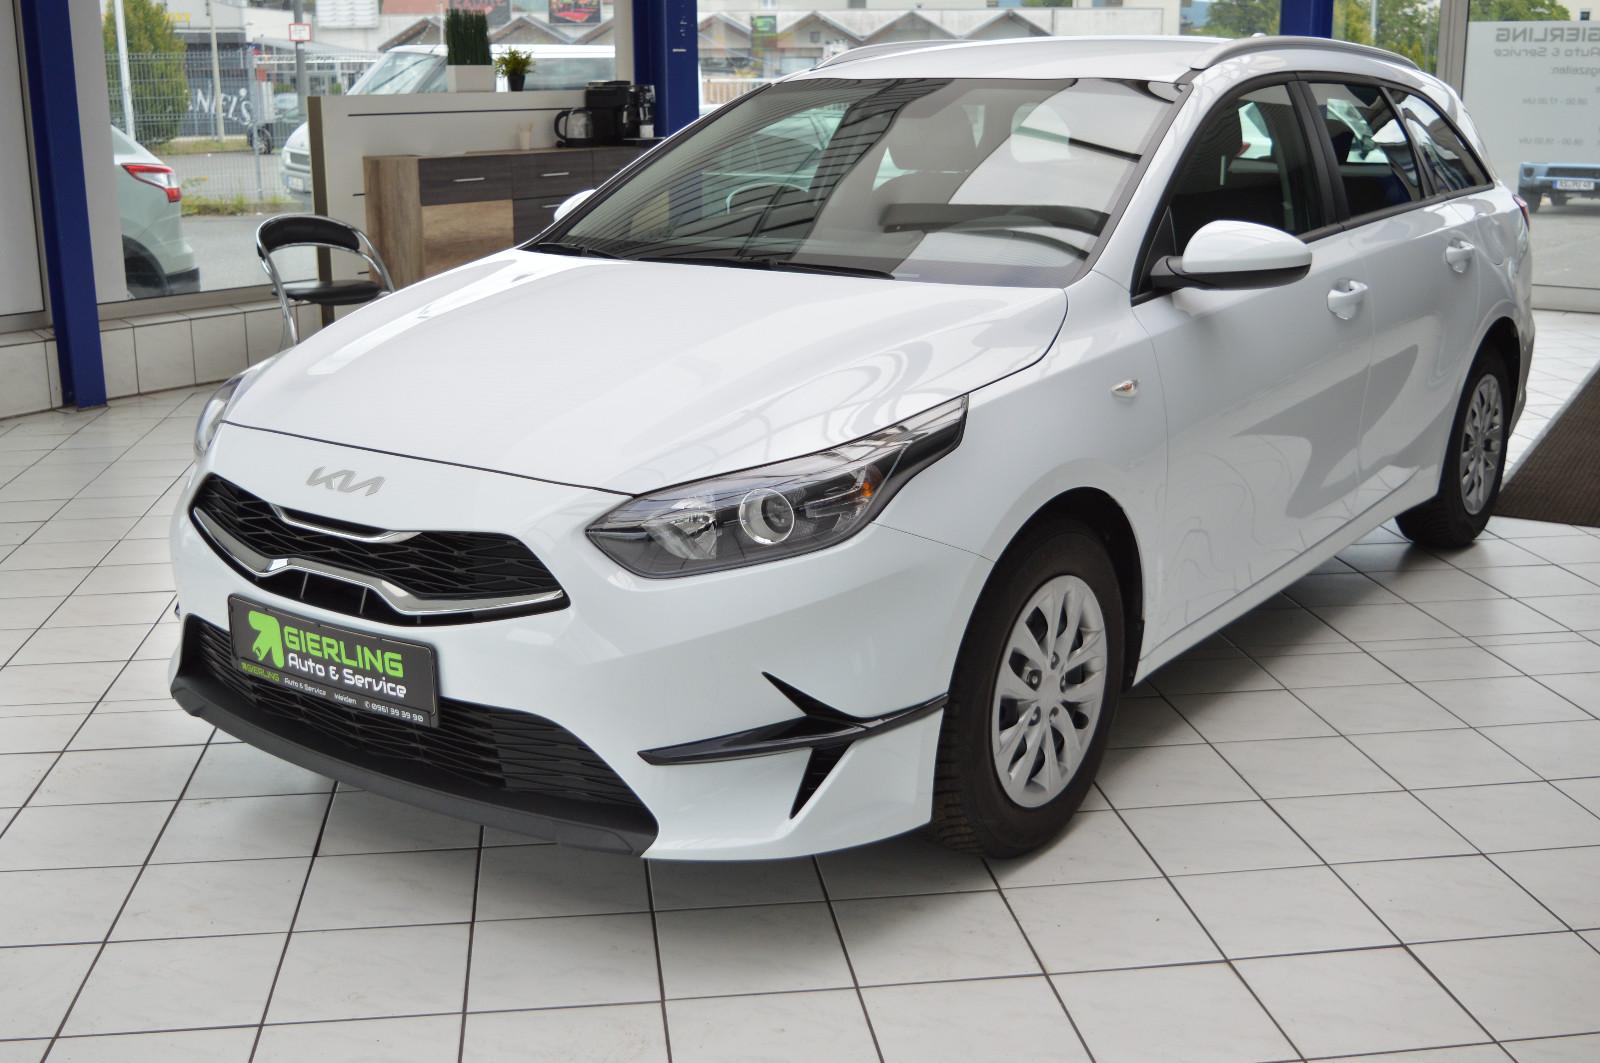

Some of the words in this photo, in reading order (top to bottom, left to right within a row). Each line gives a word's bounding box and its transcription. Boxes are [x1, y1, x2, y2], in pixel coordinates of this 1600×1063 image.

[284, 626, 404, 678] GIERLING
[288, 653, 325, 677] Auto
[330, 666, 339, 680] &
[344, 669, 407, 698] Service
[246, 663, 280, 682] GIERLING
[284, 677, 298, 688] Auto
[304, 684, 327, 696] Service
[371, 703, 389, 713] 0961
[412, 713, 424, 722] 90
